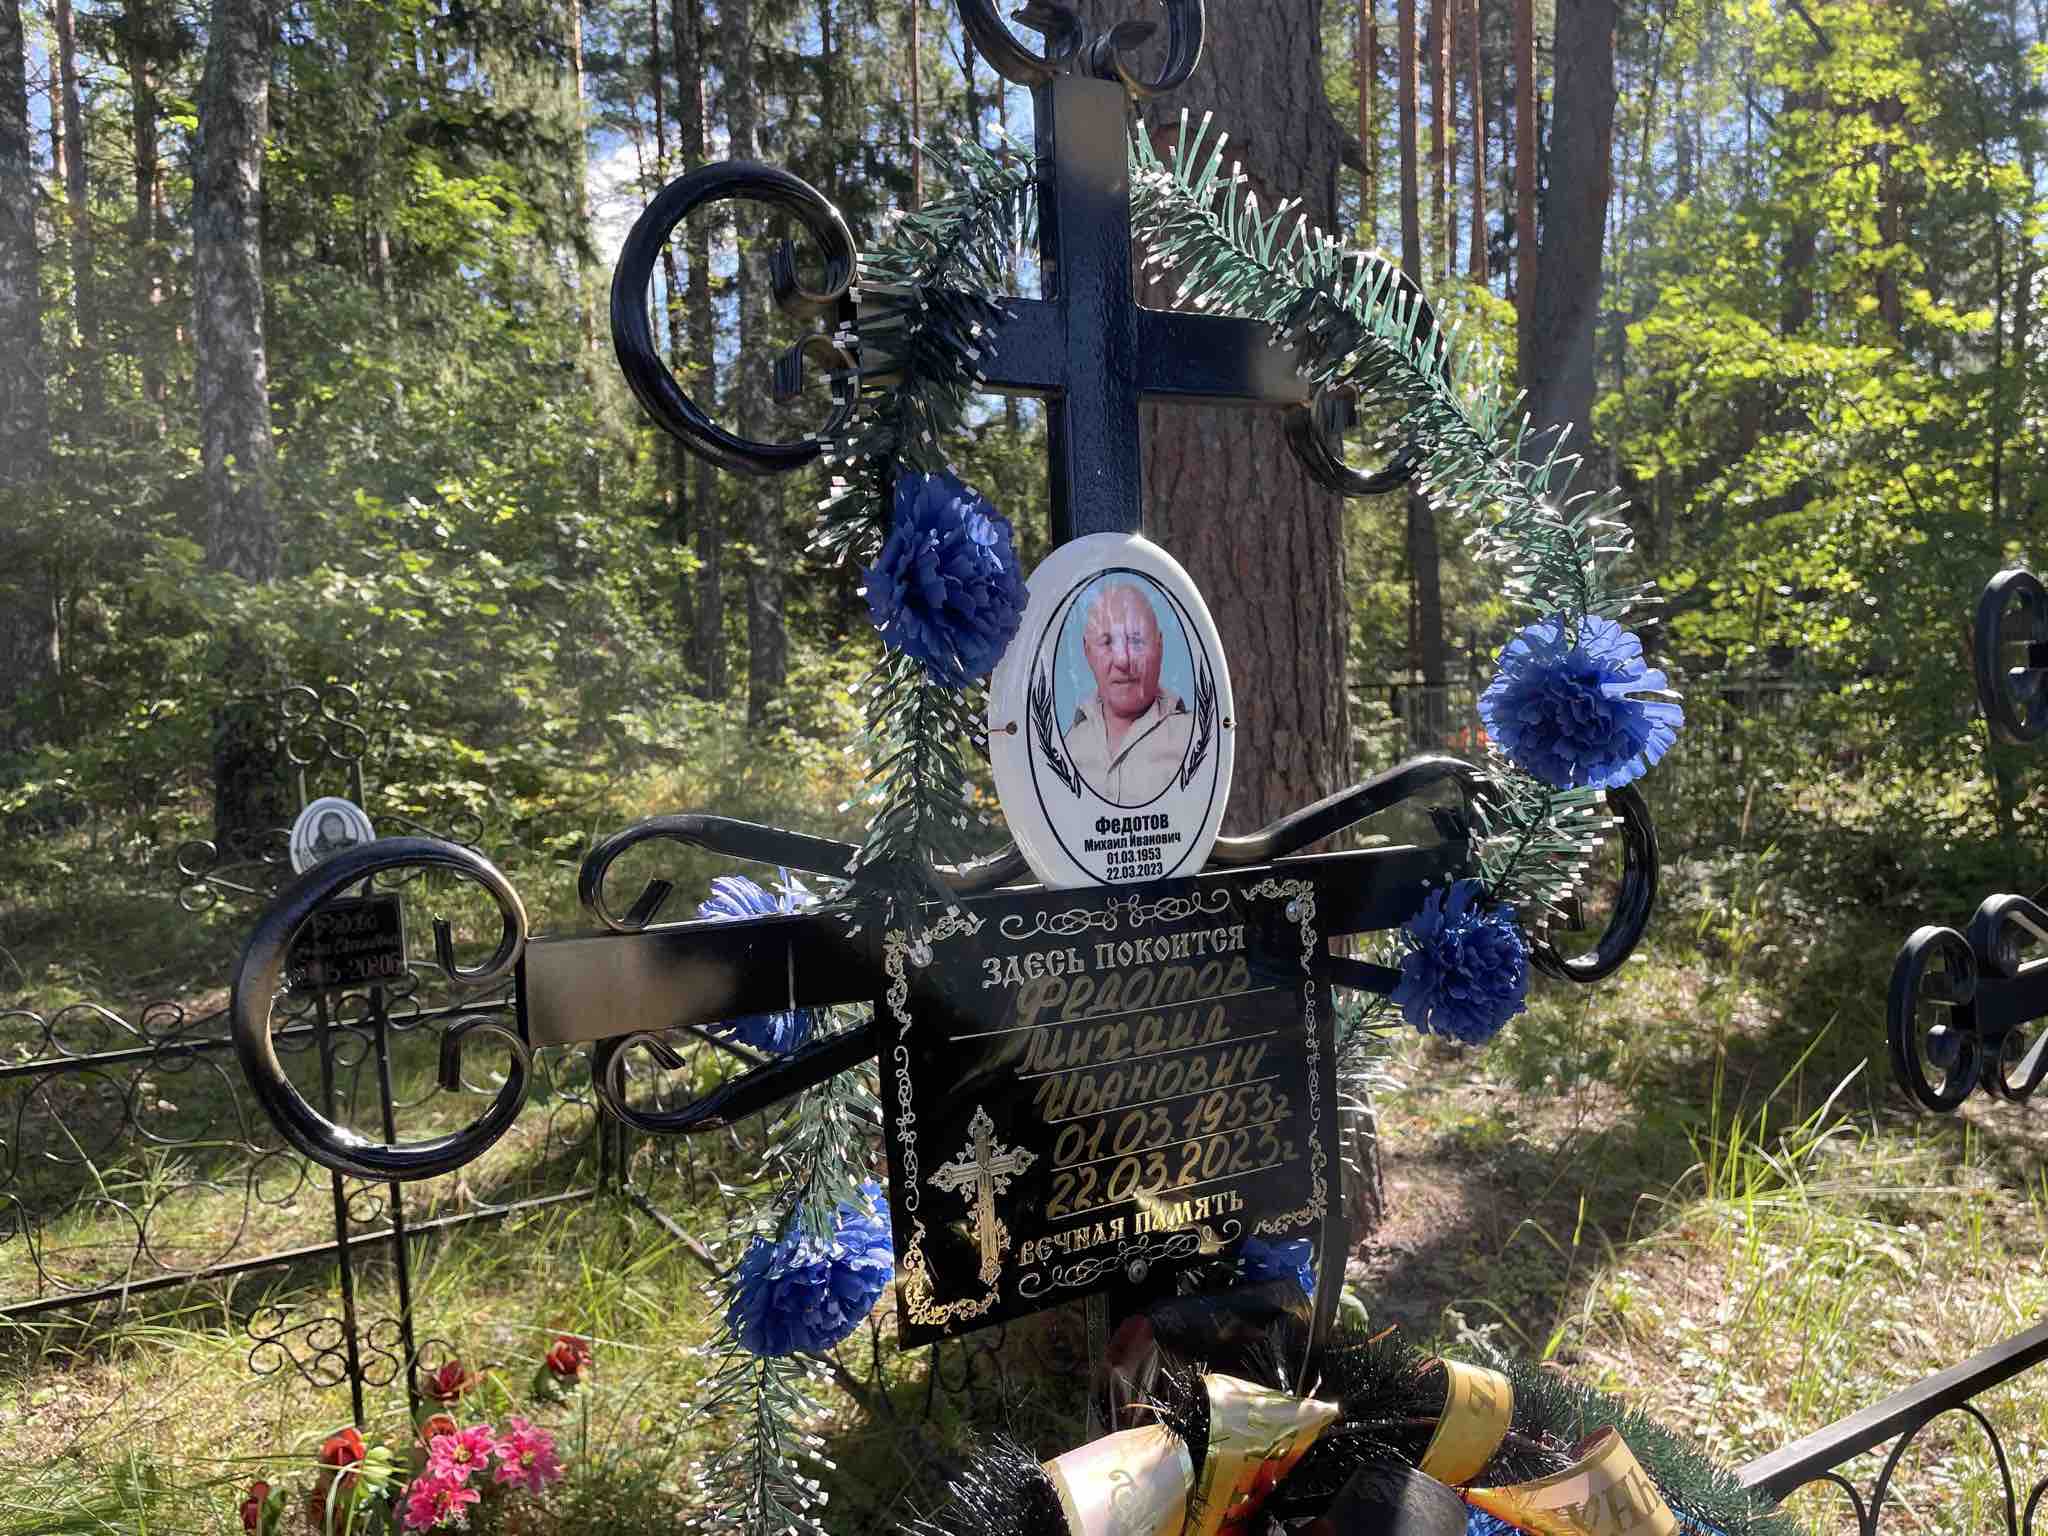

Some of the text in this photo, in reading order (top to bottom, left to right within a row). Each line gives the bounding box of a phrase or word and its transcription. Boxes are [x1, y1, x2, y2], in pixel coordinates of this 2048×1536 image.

[1084, 832, 1181, 852] Михаил Иванович
[1106, 847, 1161, 865] 01.03.1953
[1106, 862, 1163, 880] 22.03.2023
[982, 924, 1247, 989] ЗДЕСЬ ПОКОИТСЯ
[1019, 1190, 1245, 1267] ВЕЧНАЯ ПАМЯТЬ
